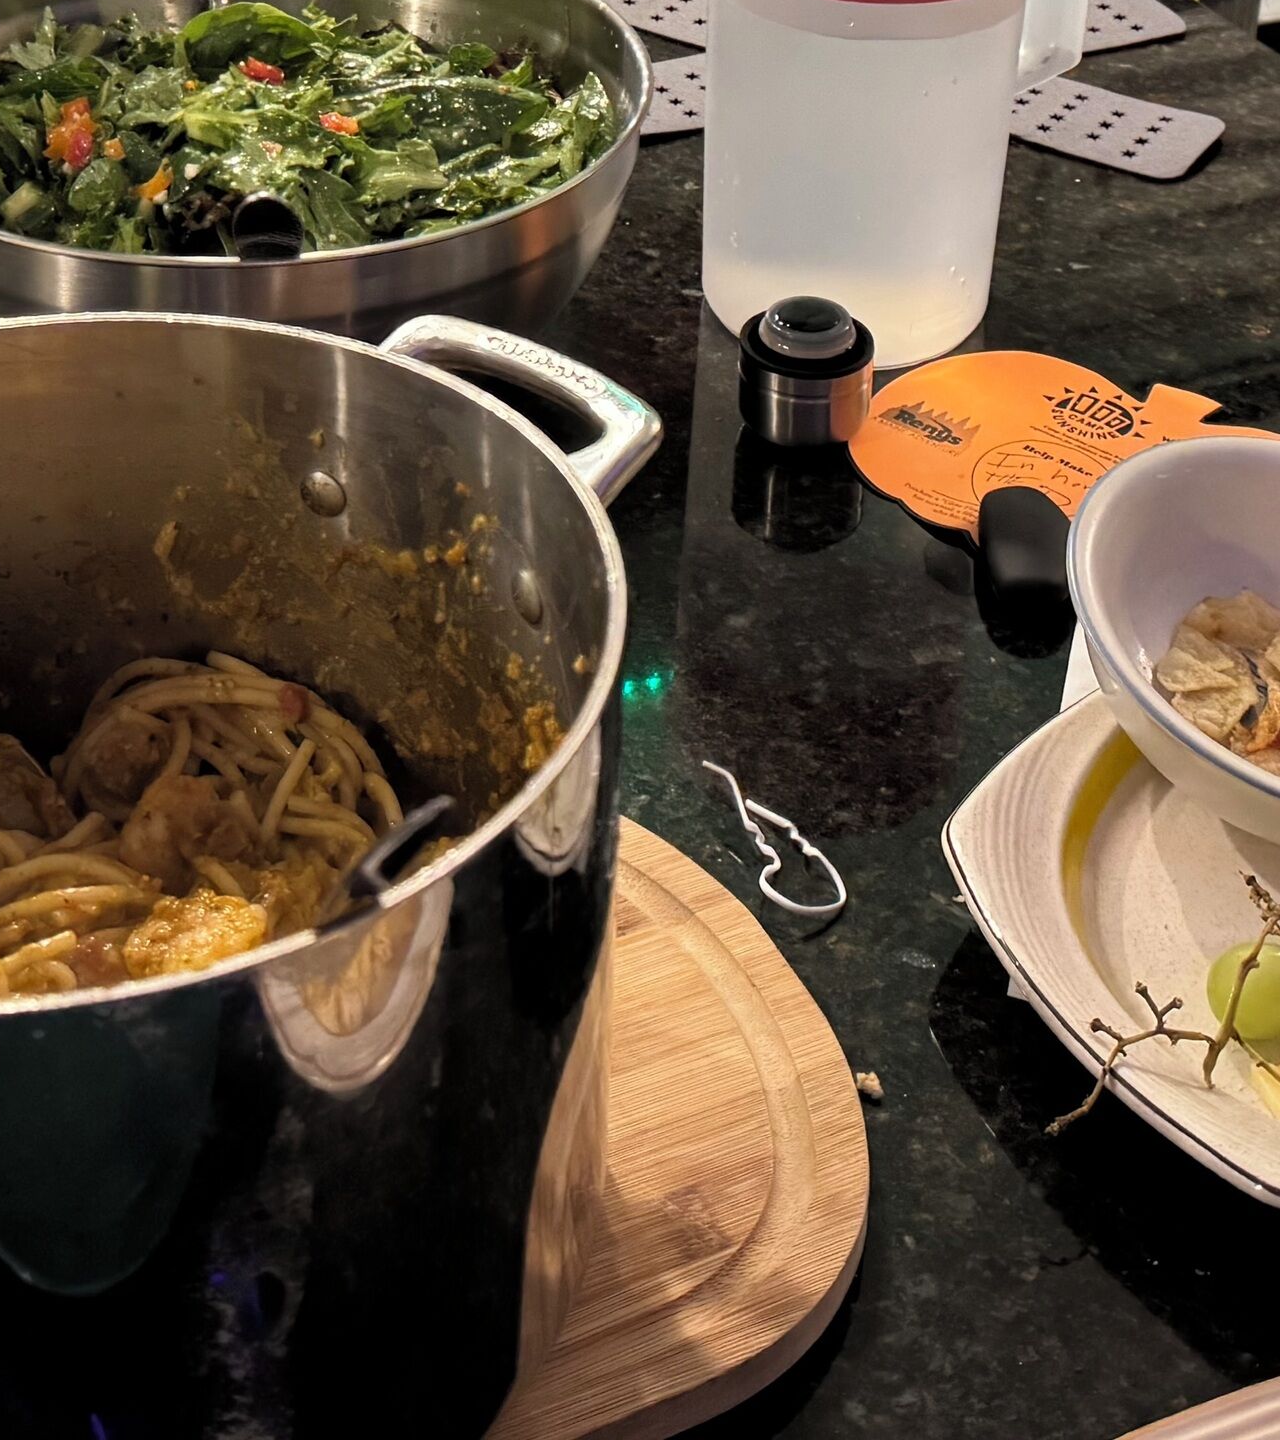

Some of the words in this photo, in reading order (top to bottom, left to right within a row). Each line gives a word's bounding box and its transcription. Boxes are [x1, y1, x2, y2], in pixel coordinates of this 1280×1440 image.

[1050, 407, 1120, 441] SUNSHINE
[1067, 412, 1105, 432] CAMP
[1021, 444, 1055, 461] Help
